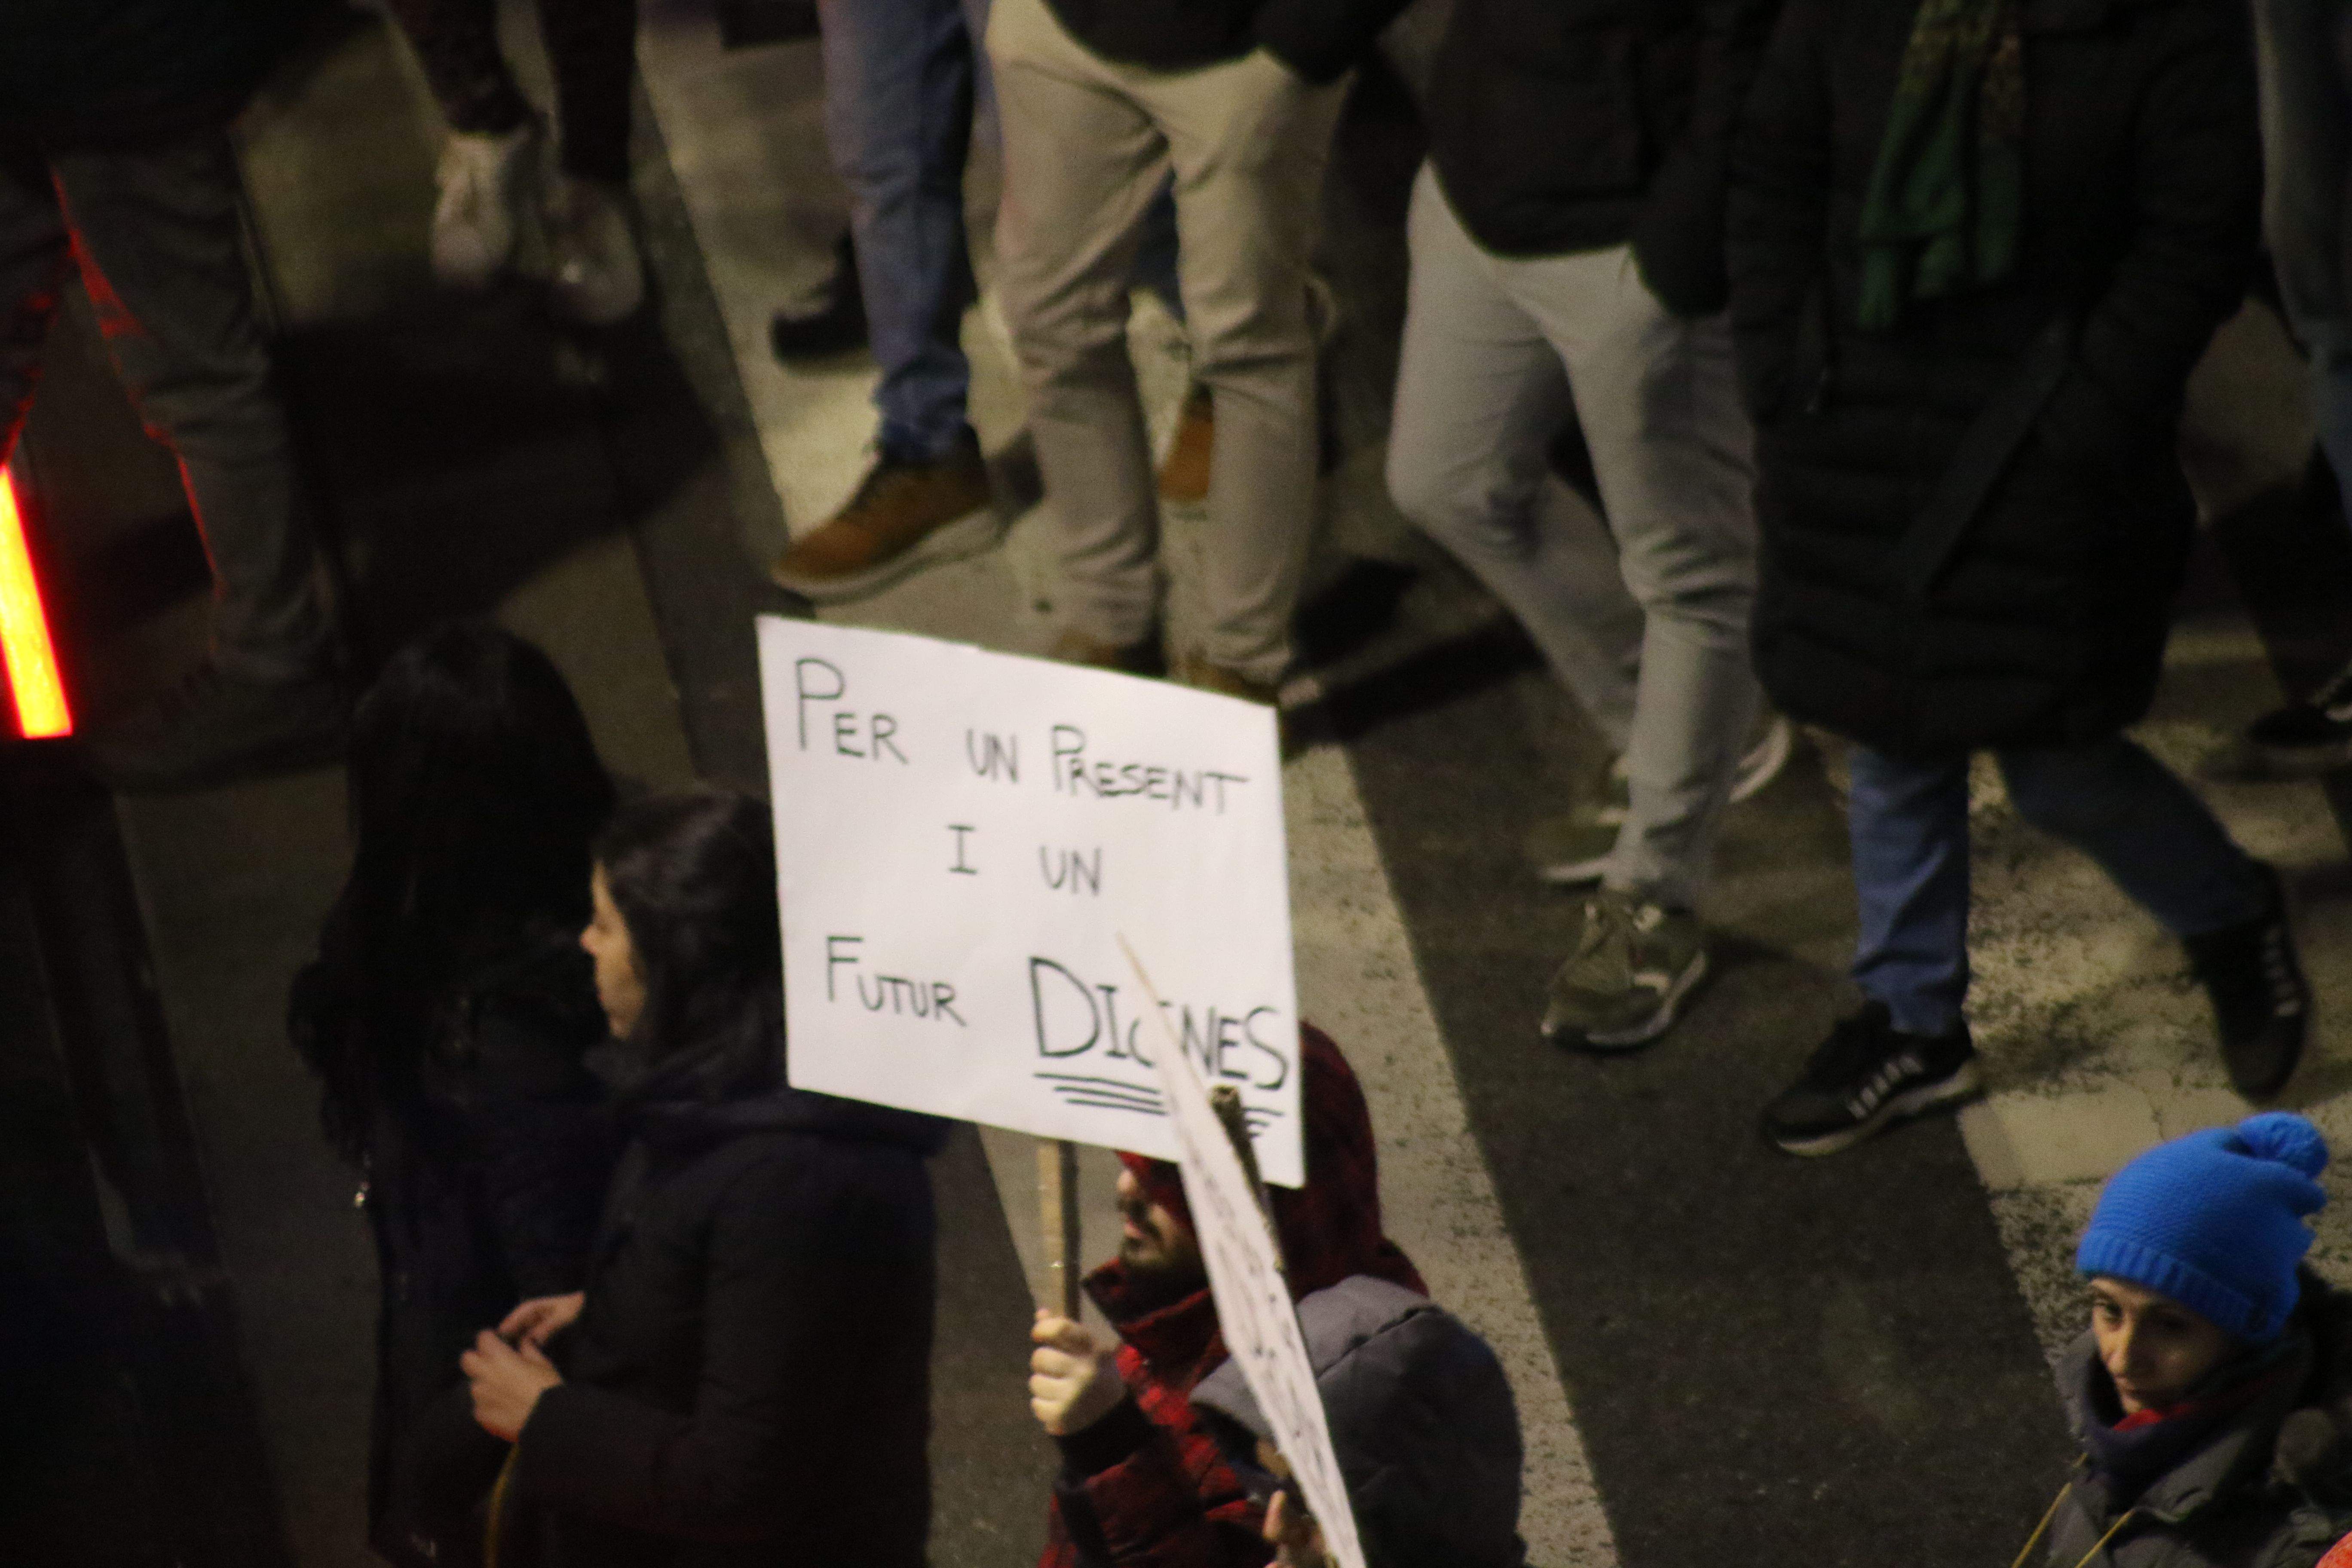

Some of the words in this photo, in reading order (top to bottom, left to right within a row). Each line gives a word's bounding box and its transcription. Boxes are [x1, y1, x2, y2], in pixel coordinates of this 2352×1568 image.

[795, 657, 909, 765] PER
[966, 727, 1020, 783] UN
[1050, 724, 1249, 815] PRESENT
[947, 823, 979, 876] I
[1039, 845, 1102, 897] UN
[826, 934, 968, 1028] FUTUR
